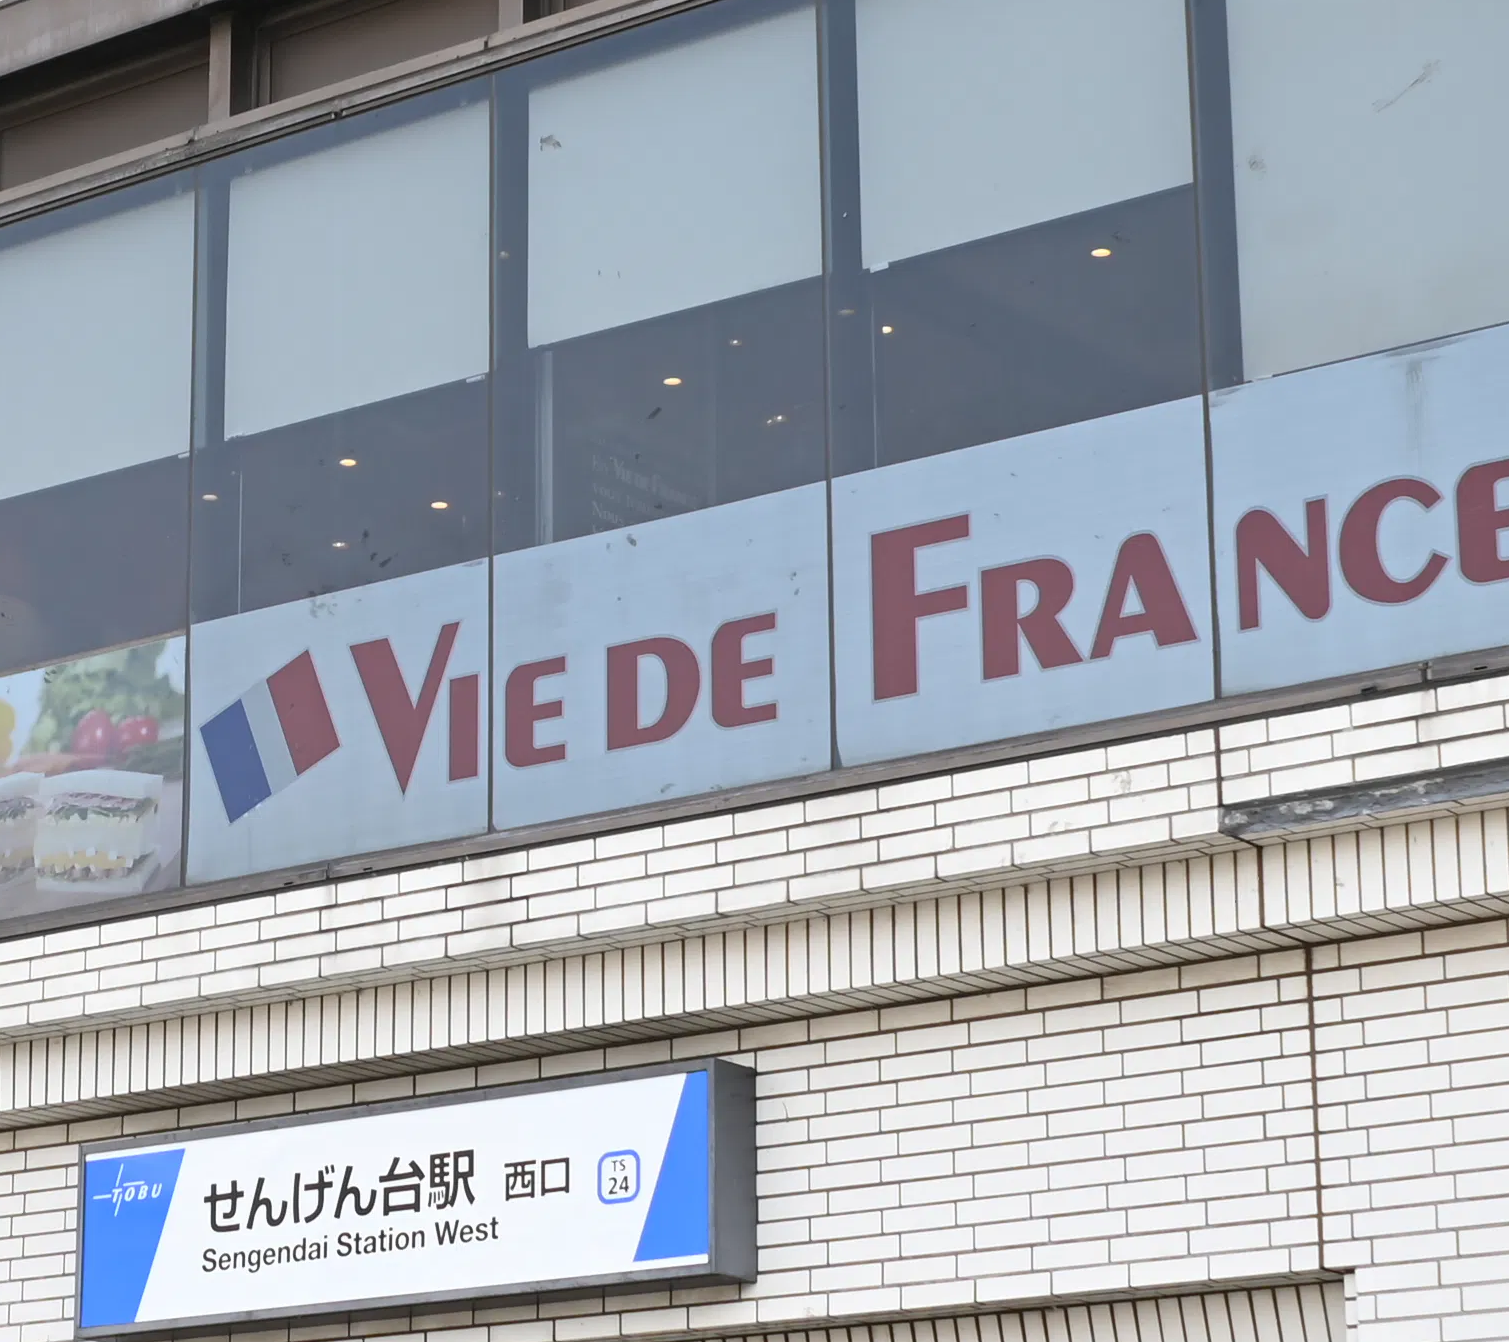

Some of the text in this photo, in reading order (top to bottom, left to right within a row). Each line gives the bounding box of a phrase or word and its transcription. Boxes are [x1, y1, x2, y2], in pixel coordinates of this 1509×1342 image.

[611, 1160, 626, 1173] TS
[203, 1149, 571, 1233] せんげん台駅 西口
[608, 1176, 630, 1196] 24
[202, 1216, 500, 1273] Sengendai Station West
